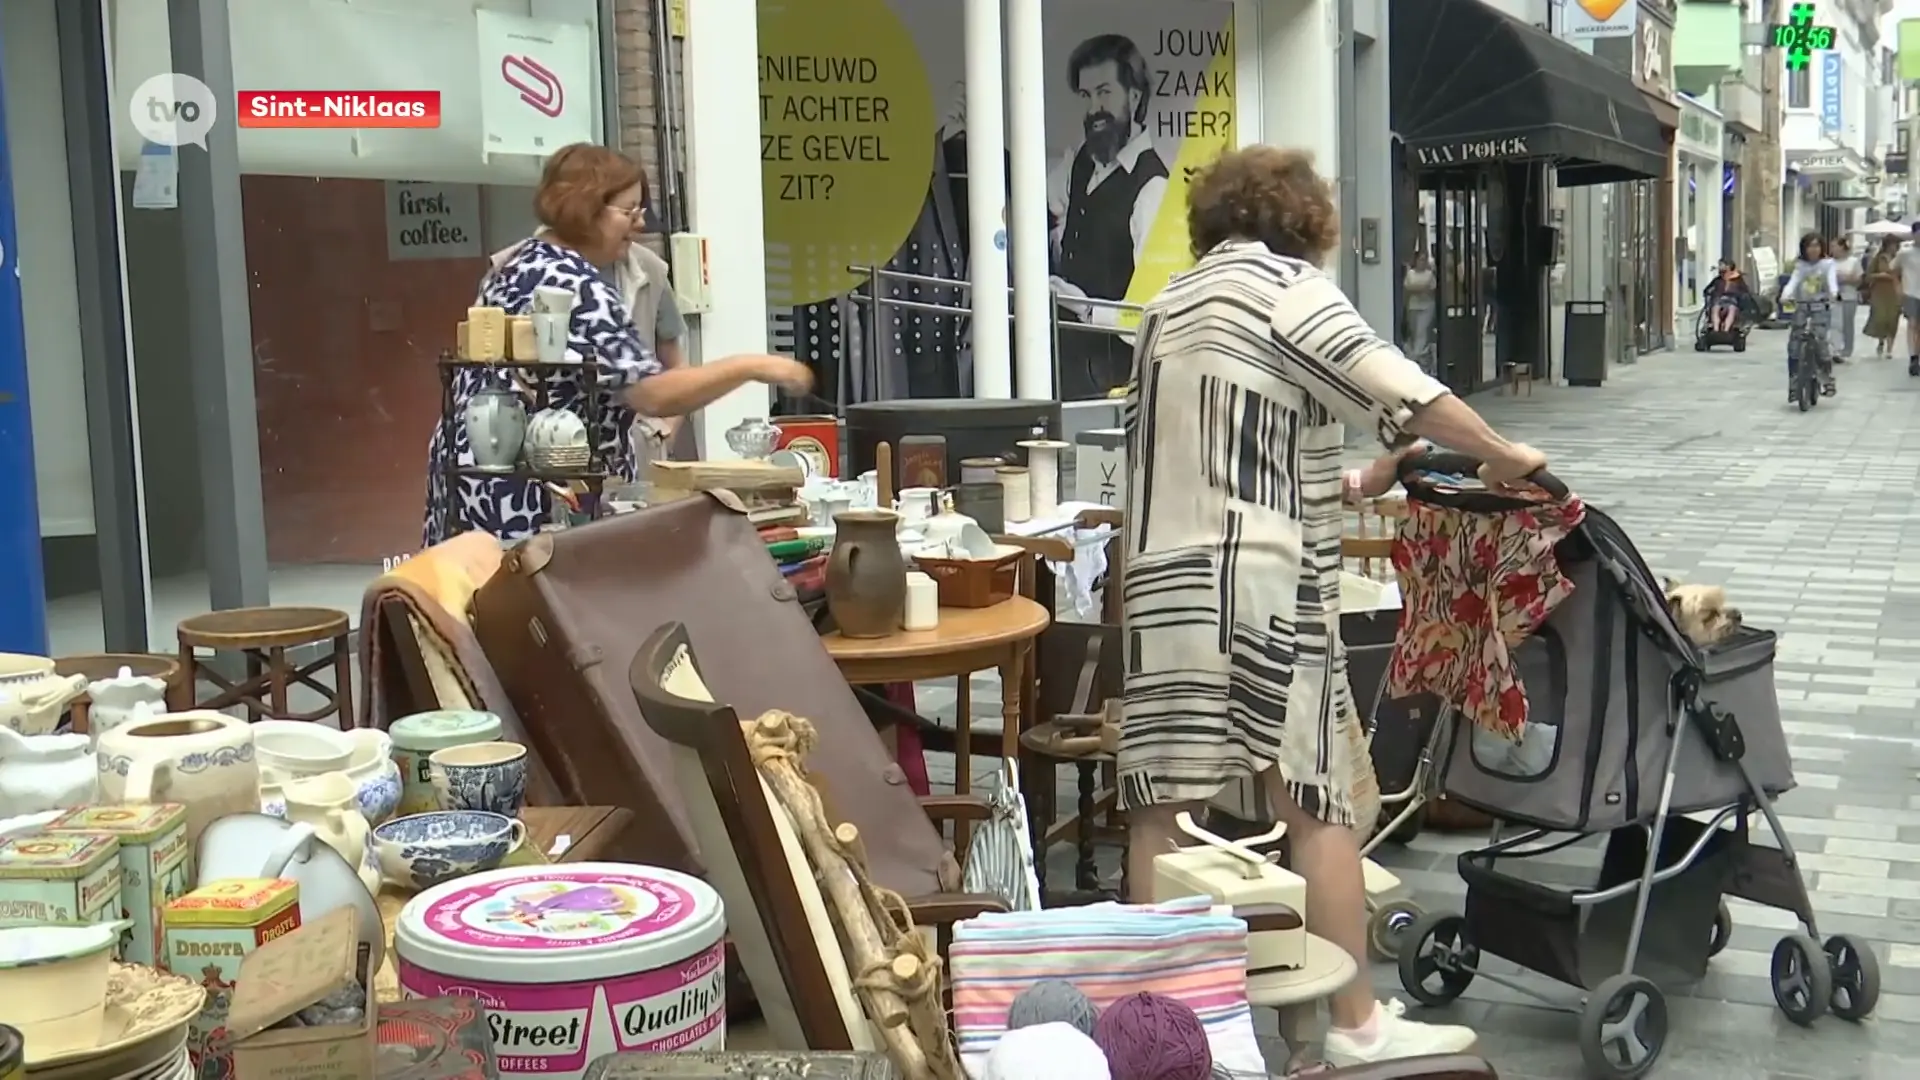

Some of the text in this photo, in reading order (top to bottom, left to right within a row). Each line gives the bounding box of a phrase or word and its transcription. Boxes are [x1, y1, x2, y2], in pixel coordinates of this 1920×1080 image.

[1154, 28, 1230, 57] JOUW
[1775, 26, 1831, 49] 10:56
[1156, 70, 1232, 98] ZAAK
[1825, 58, 1839, 127] OPTIEK
[782, 96, 889, 122] ACHTER
[1157, 111, 1232, 138] HIER?
[803, 135, 890, 161] GEVEL
[1418, 144, 1455, 165] VAN
[1801, 156, 1846, 167] OPTIEK
[780, 174, 835, 201] ZIT?
[399, 189, 452, 216] first,
[400, 219, 469, 246] coffee.
[262, 917, 296, 942] DROSTE
[176, 939, 245, 957] DROSTE
[624, 987, 708, 1037] Quality
[487, 1012, 580, 1047] Street
